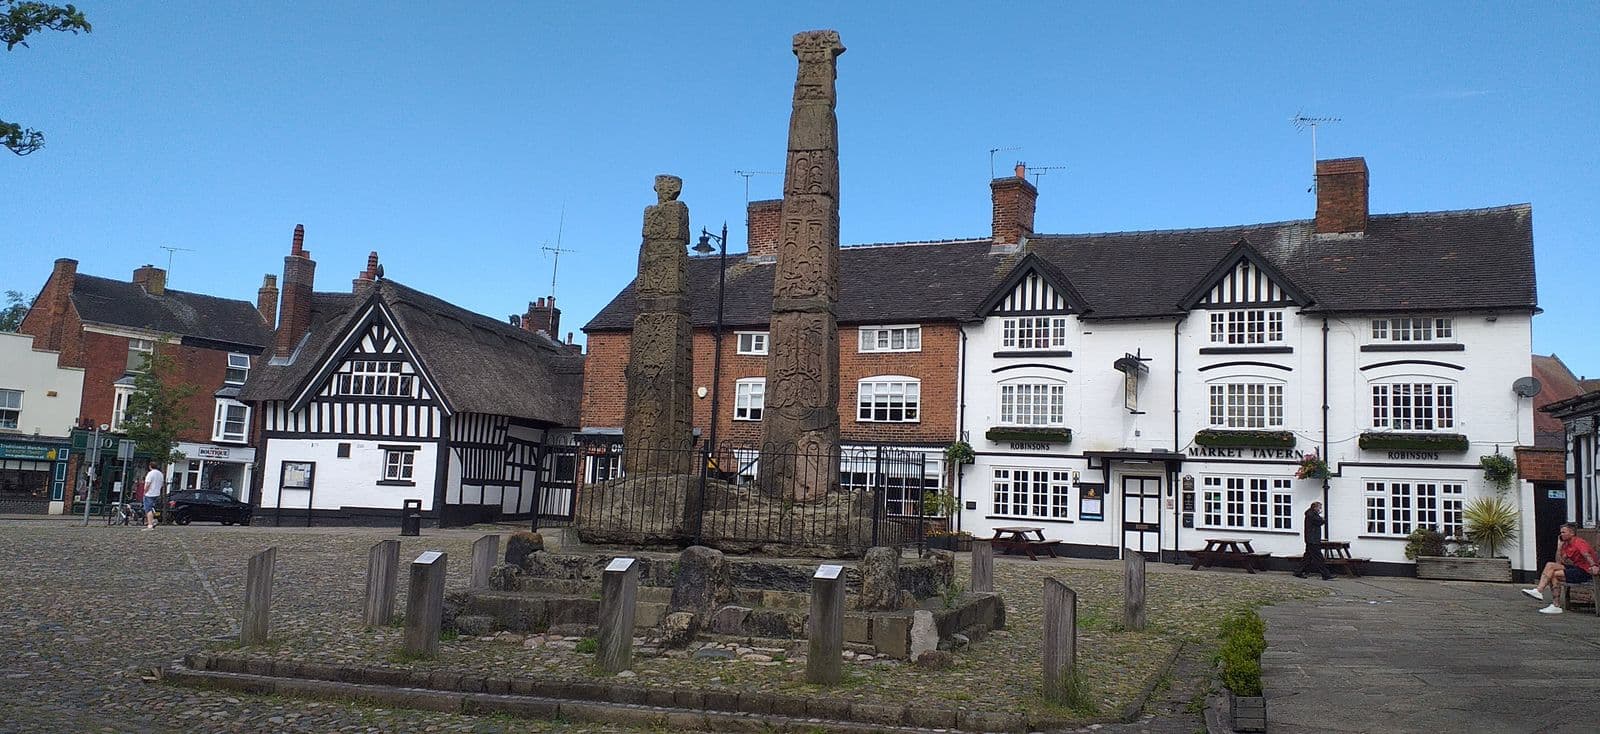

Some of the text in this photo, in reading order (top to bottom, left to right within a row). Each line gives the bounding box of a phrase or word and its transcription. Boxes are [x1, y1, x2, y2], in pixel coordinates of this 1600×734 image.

[1010, 442, 1050, 450] ROBINSONS
[1188, 447, 1304, 459] MARKET TAVERN
[1388, 451, 1439, 460] ROBINSONS
